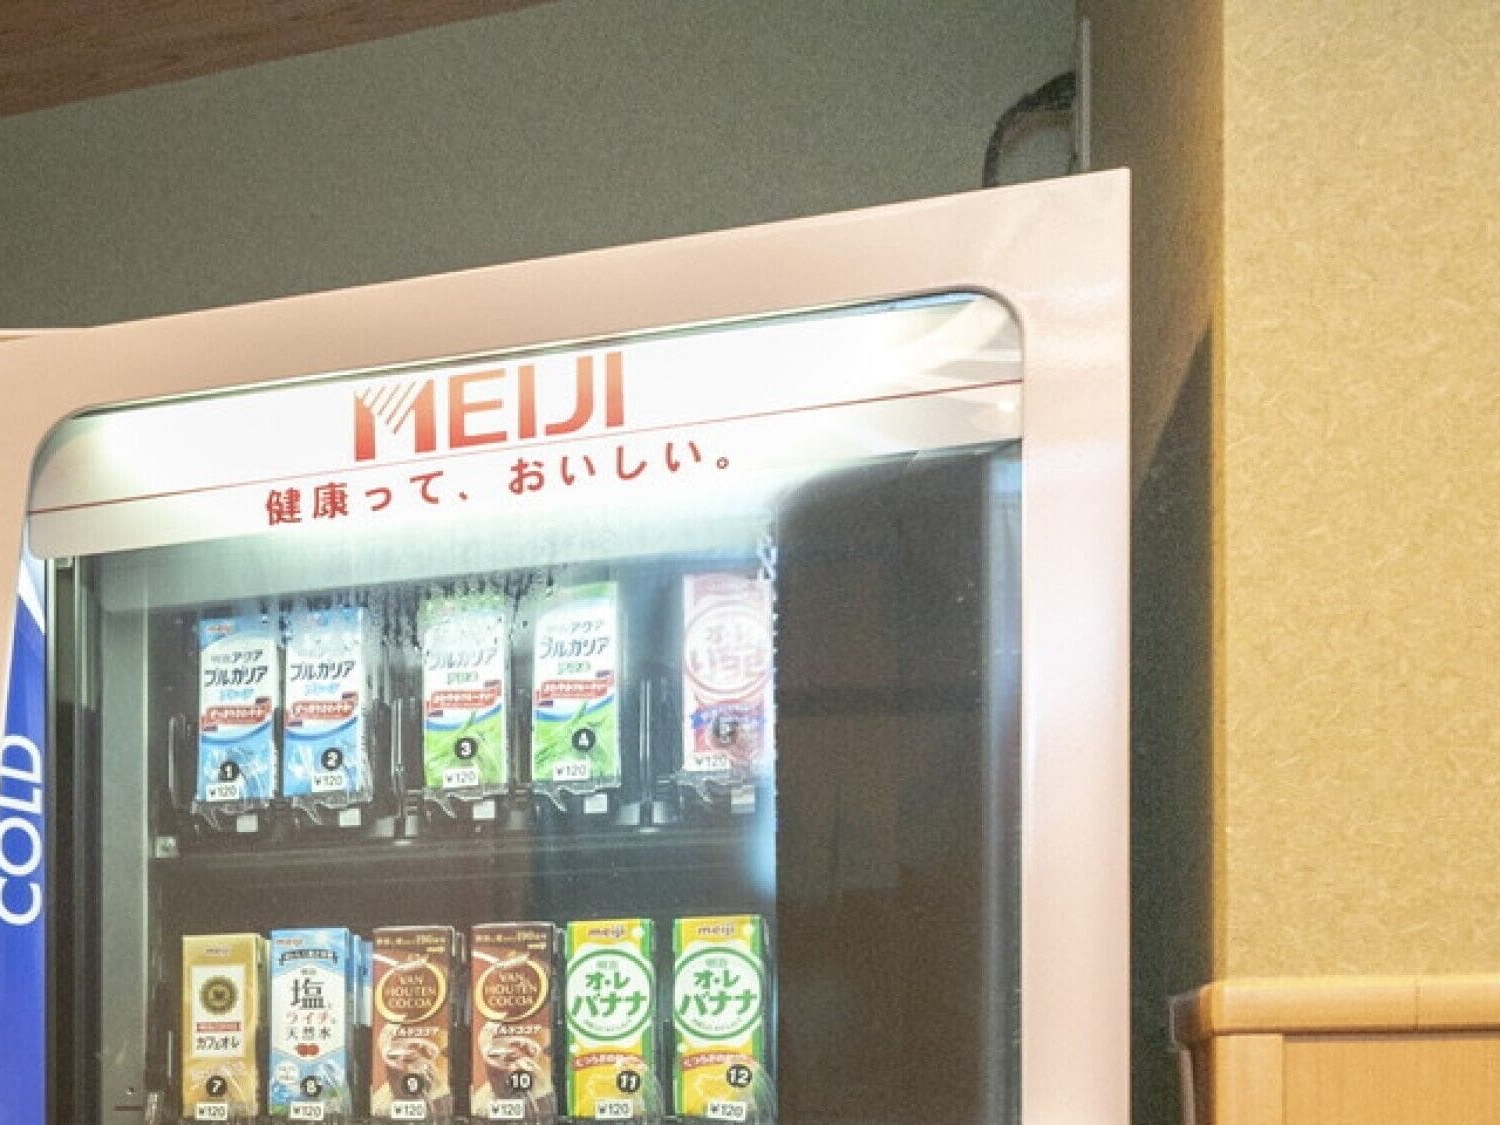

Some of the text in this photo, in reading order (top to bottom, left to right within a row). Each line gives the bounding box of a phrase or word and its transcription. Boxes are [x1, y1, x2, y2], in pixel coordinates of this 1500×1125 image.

[354, 352, 625, 463] MEIJI
[265, 440, 731, 527] 健康って、おいしい。
[697, 925, 736, 937] meiji
[571, 990, 647, 1017] バナナ
[680, 988, 757, 1016] バナナ
